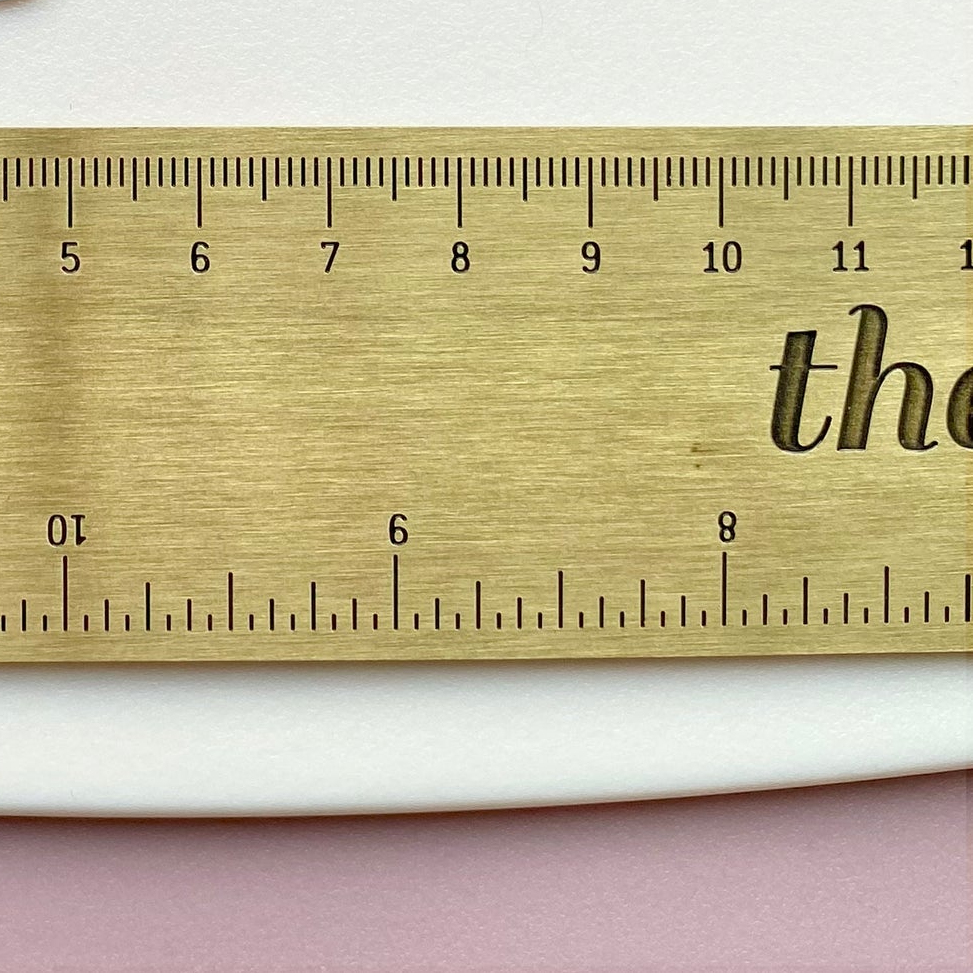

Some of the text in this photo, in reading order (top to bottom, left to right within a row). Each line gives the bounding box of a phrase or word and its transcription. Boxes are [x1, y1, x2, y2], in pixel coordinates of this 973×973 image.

[61, 241, 81, 274] 5
[190, 241, 211, 274] 6
[320, 241, 340, 274] 7
[451, 241, 471, 274] 8
[581, 241, 601, 274] 9
[702, 240, 742, 273] 10
[832, 240, 870, 272] 11
[47, 514, 87, 547] 10
[388, 513, 409, 546] 9
[717, 510, 737, 543] 8
